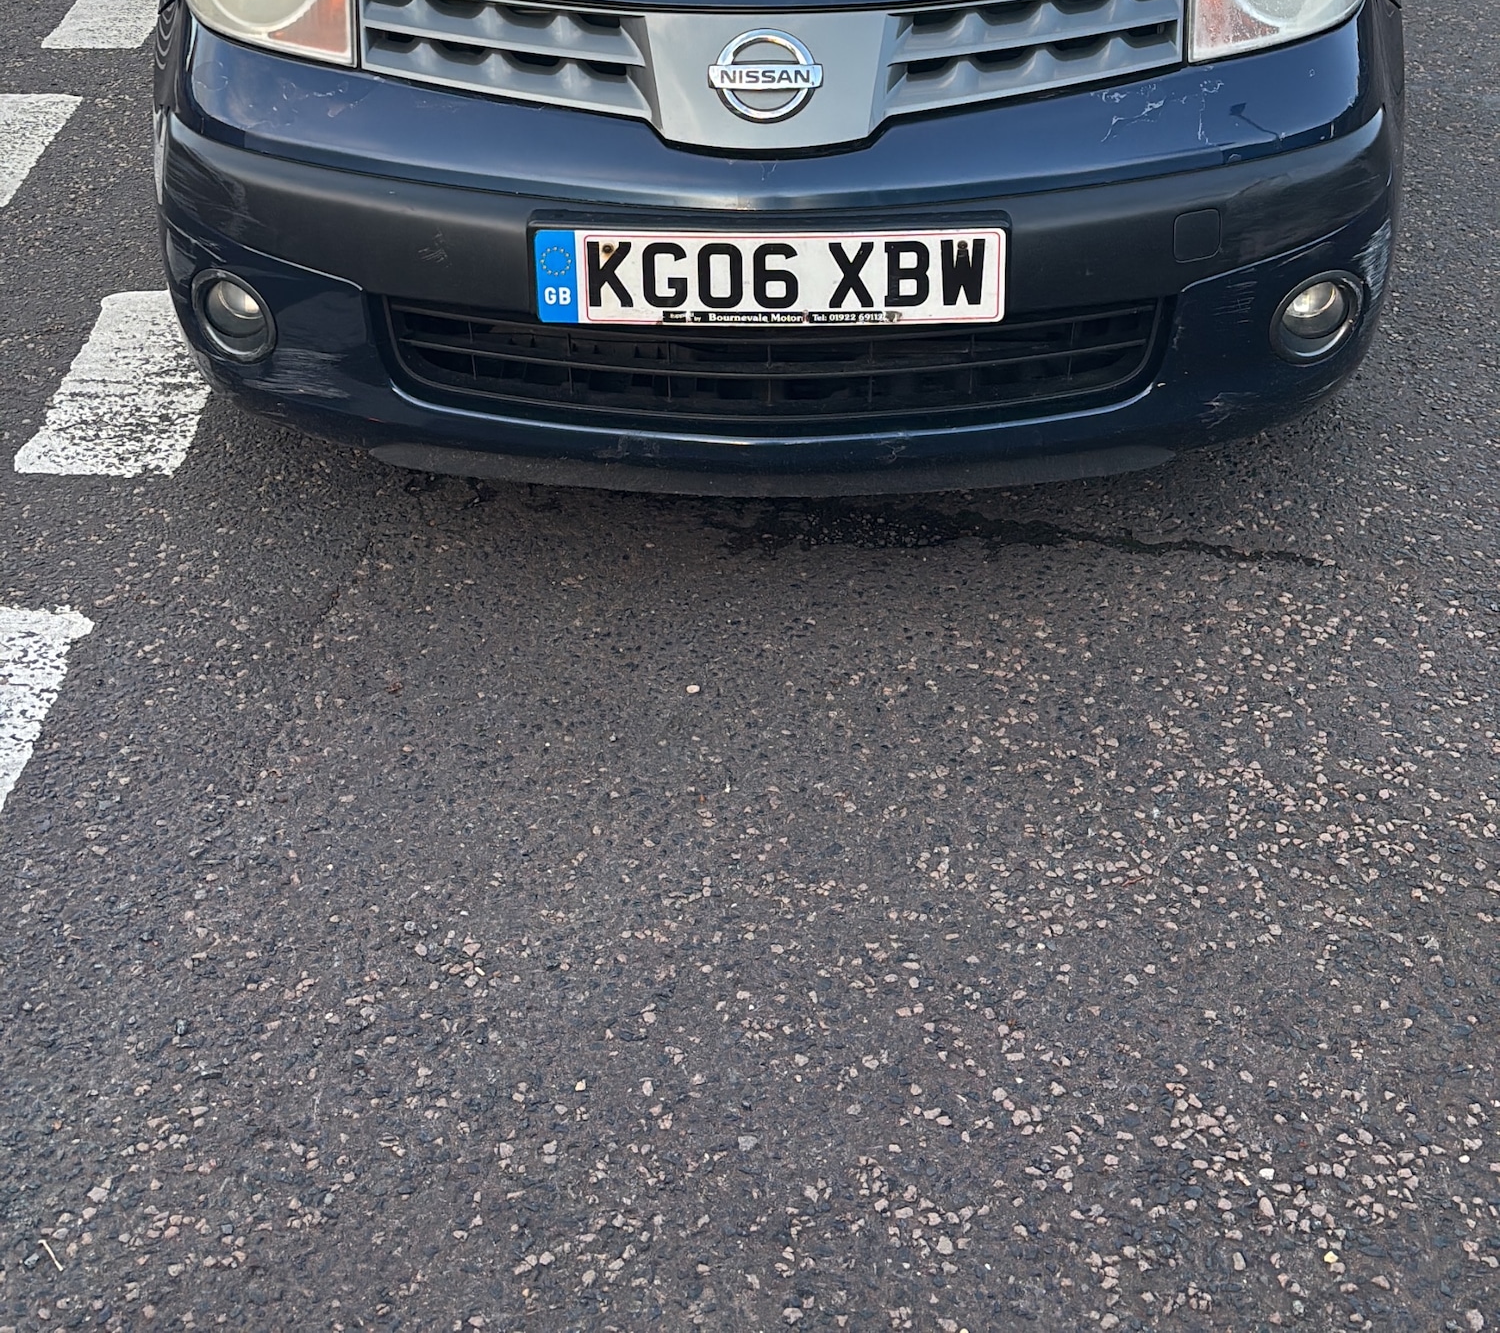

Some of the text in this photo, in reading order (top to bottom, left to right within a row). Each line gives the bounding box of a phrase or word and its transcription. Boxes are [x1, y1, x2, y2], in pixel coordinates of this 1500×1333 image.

[720, 69, 810, 84] NISSAN
[586, 239, 986, 309] KG06 XBW
[544, 286, 571, 305] GB
[708, 312, 769, 323] Bournevale
[770, 313, 807, 323] Motor
[812, 313, 827, 322] Tel:
[829, 313, 856, 322] 01922
